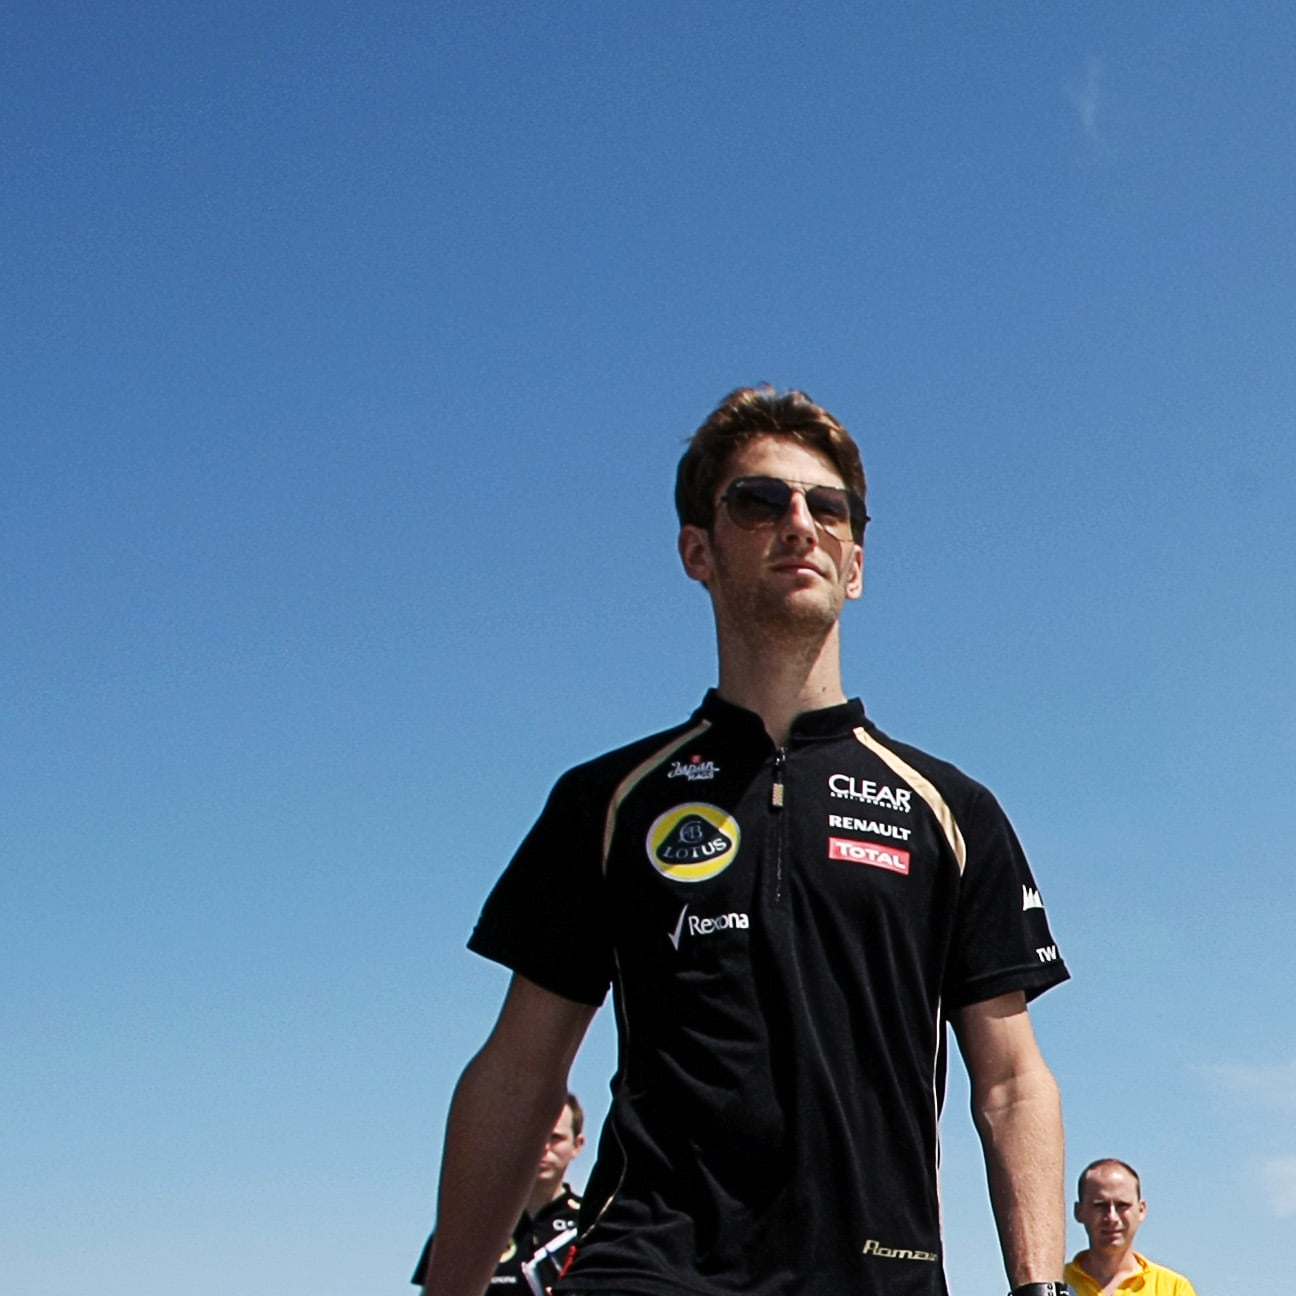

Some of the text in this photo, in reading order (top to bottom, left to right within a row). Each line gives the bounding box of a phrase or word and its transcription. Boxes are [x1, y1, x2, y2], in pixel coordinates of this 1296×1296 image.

[828, 774, 912, 810] CLEAR
[828, 814, 911, 841] RENAULT
[663, 838, 727, 859] LOTUS
[834, 841, 906, 870] TOTAL
[688, 912, 750, 936] Rexona
